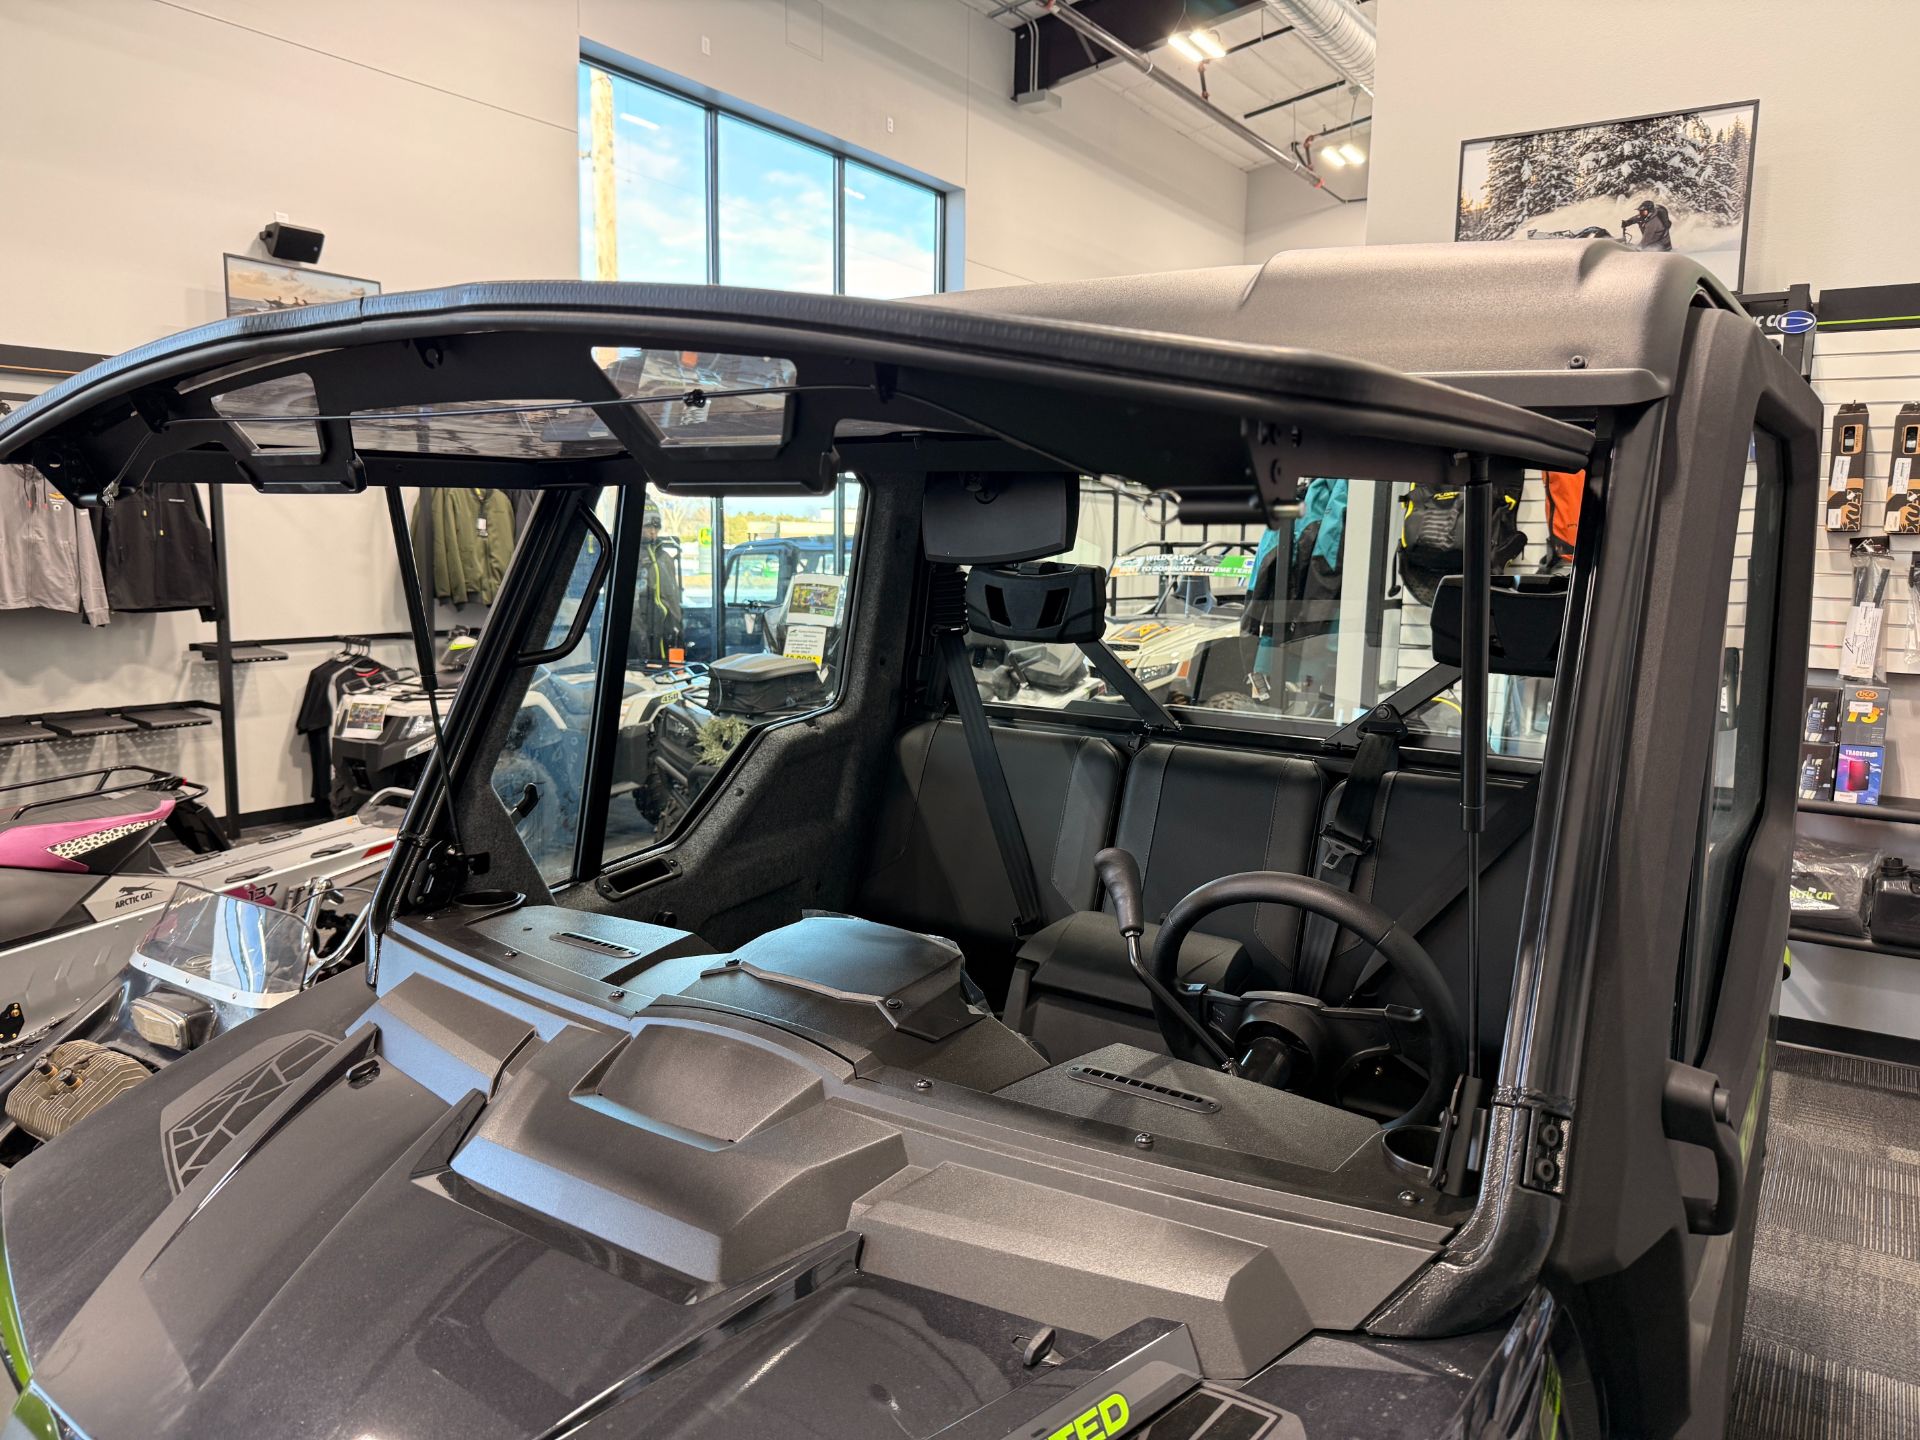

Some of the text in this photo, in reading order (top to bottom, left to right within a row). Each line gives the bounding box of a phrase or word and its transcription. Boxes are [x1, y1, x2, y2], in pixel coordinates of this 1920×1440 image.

[1145, 553, 1197, 565] WILDCAT XX
[1194, 566, 1232, 574] EXTREME
[248, 883, 278, 901] 137
[1816, 891, 1836, 901] CAT
[115, 891, 153, 909] ARCTIC CAT
